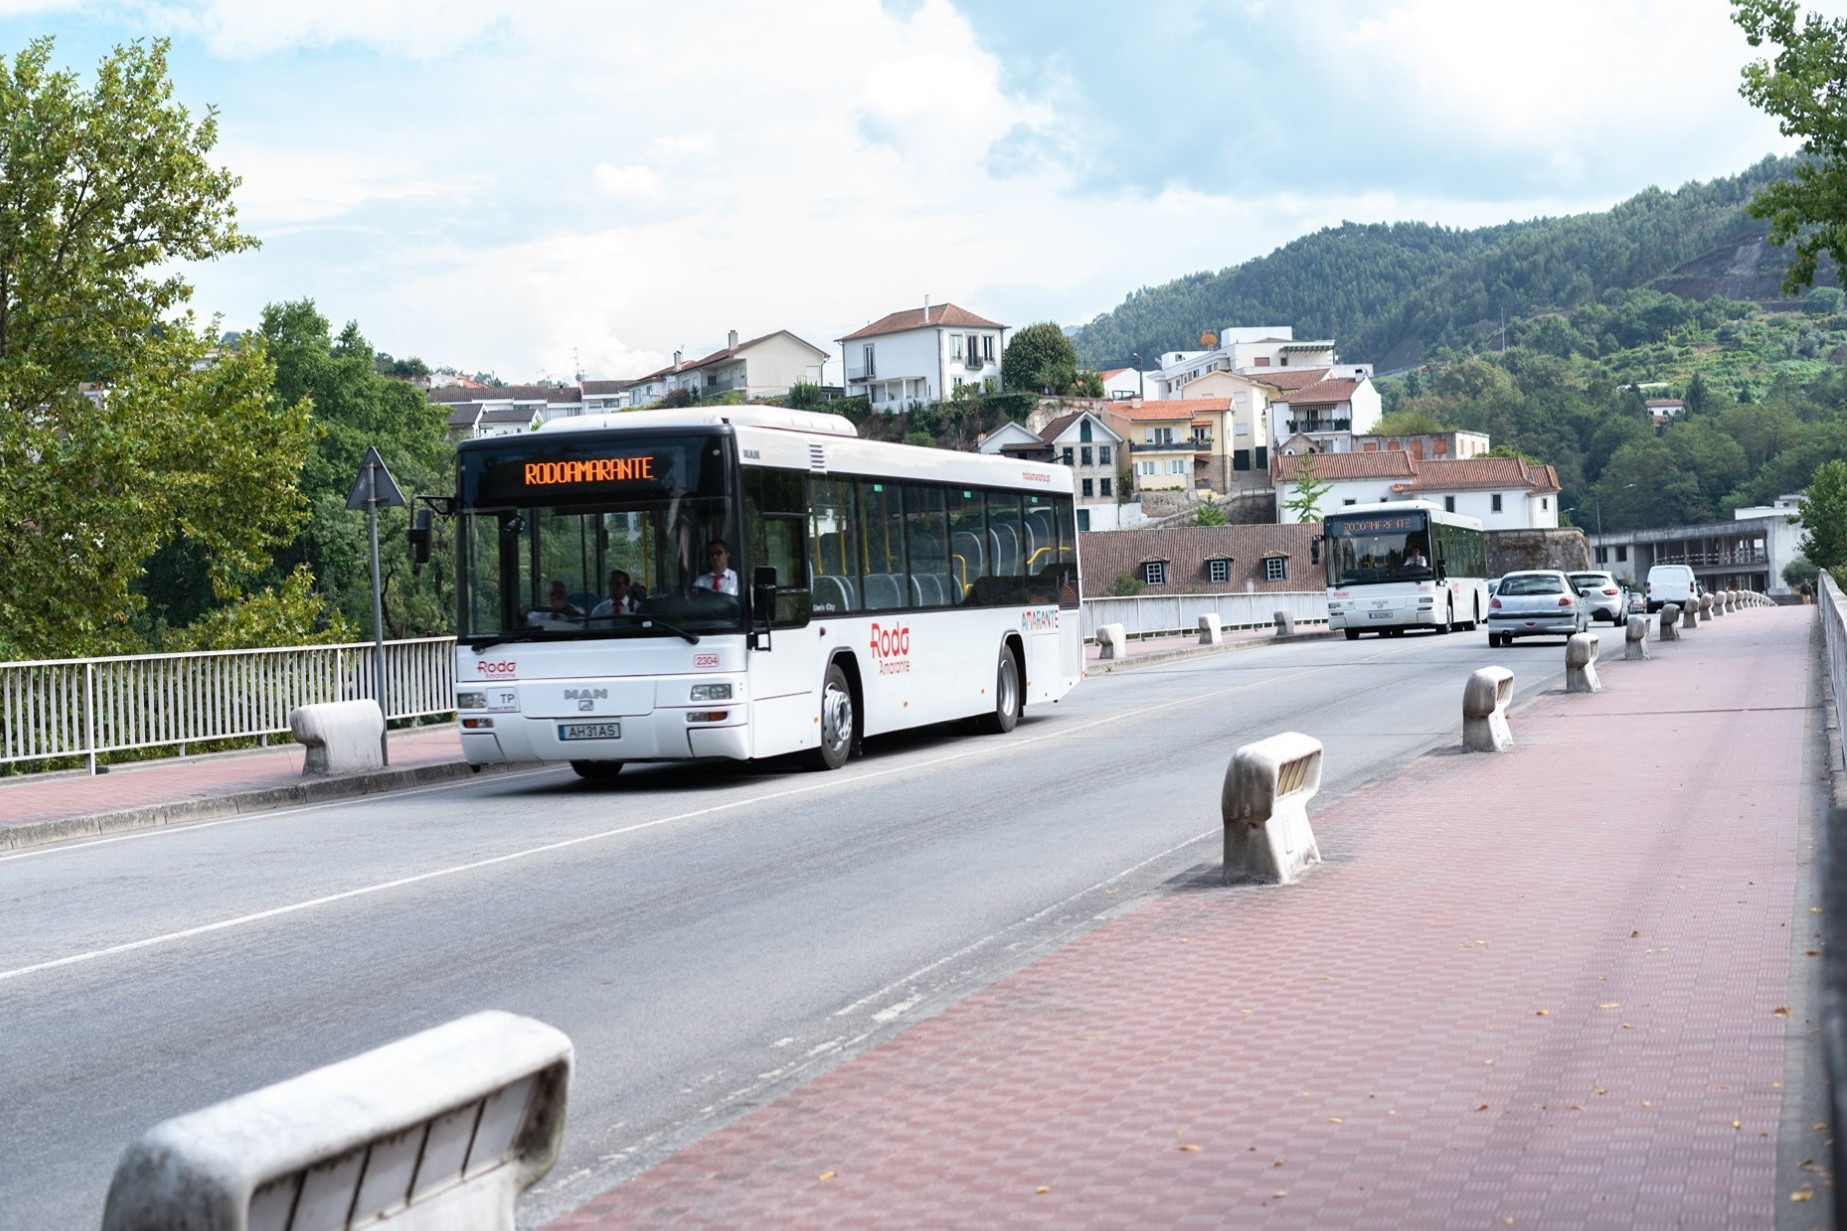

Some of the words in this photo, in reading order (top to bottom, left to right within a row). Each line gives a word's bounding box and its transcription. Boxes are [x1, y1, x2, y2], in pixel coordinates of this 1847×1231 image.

[525, 456, 654, 485] RODOAMARANTE
[1021, 609, 1059, 631] AMARANTE
[870, 621, 910, 659] Rodo
[477, 660, 516, 673] Rodo
[696, 656, 718, 666] 2304
[500, 693, 515, 704] TP
[564, 689, 608, 700] MAN
